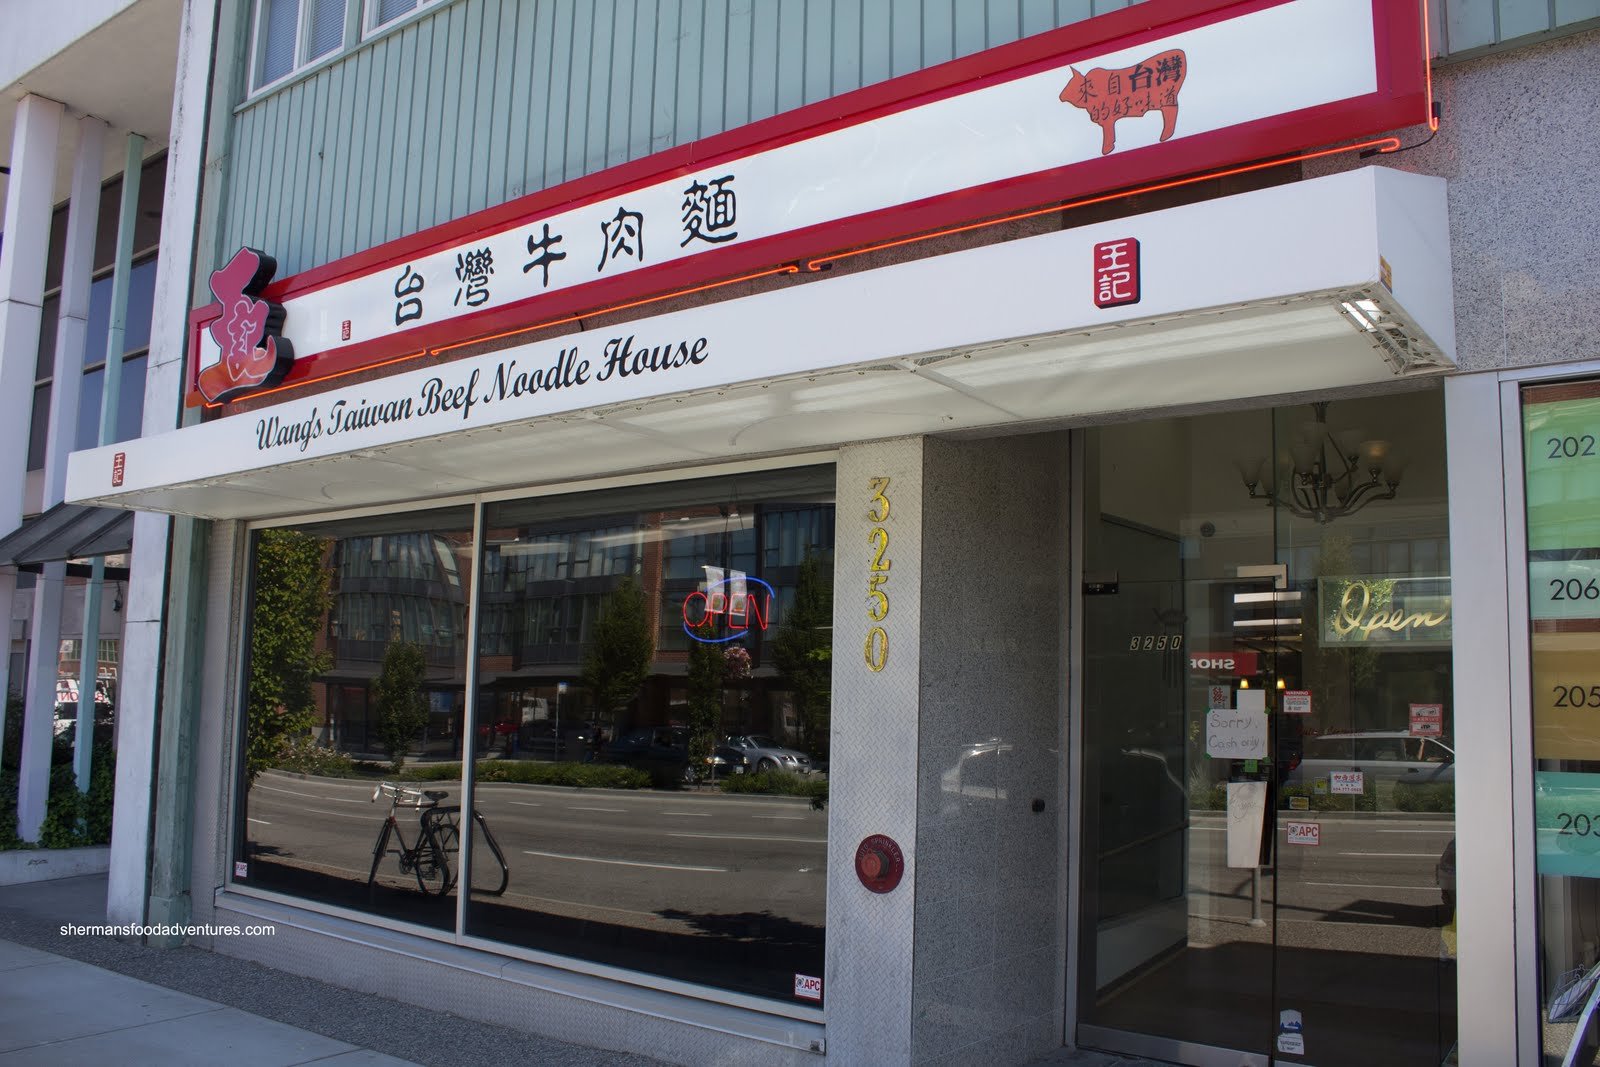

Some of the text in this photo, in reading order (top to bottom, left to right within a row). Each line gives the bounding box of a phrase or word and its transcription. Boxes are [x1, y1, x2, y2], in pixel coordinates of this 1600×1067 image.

[1078, 55, 1183, 103] 來自台灣
[1090, 86, 1178, 121] 的好味道
[394, 174, 739, 327] 台灣牛肉麵
[1097, 242, 1132, 302] 王記
[256, 334, 709, 452] Wang's Taiwan Beef Noodle House
[1547, 434, 1596, 459] 202
[864, 476, 891, 673] 3250
[1550, 578, 1600, 601] 206
[683, 591, 770, 631] OPEN
[1334, 582, 1450, 641] Open
[1130, 635, 1183, 650] 3250
[1553, 685, 1600, 708] 205
[1208, 734, 1238, 749] Cash
[1299, 826, 1318, 837] APC
[804, 979, 820, 991] APC
